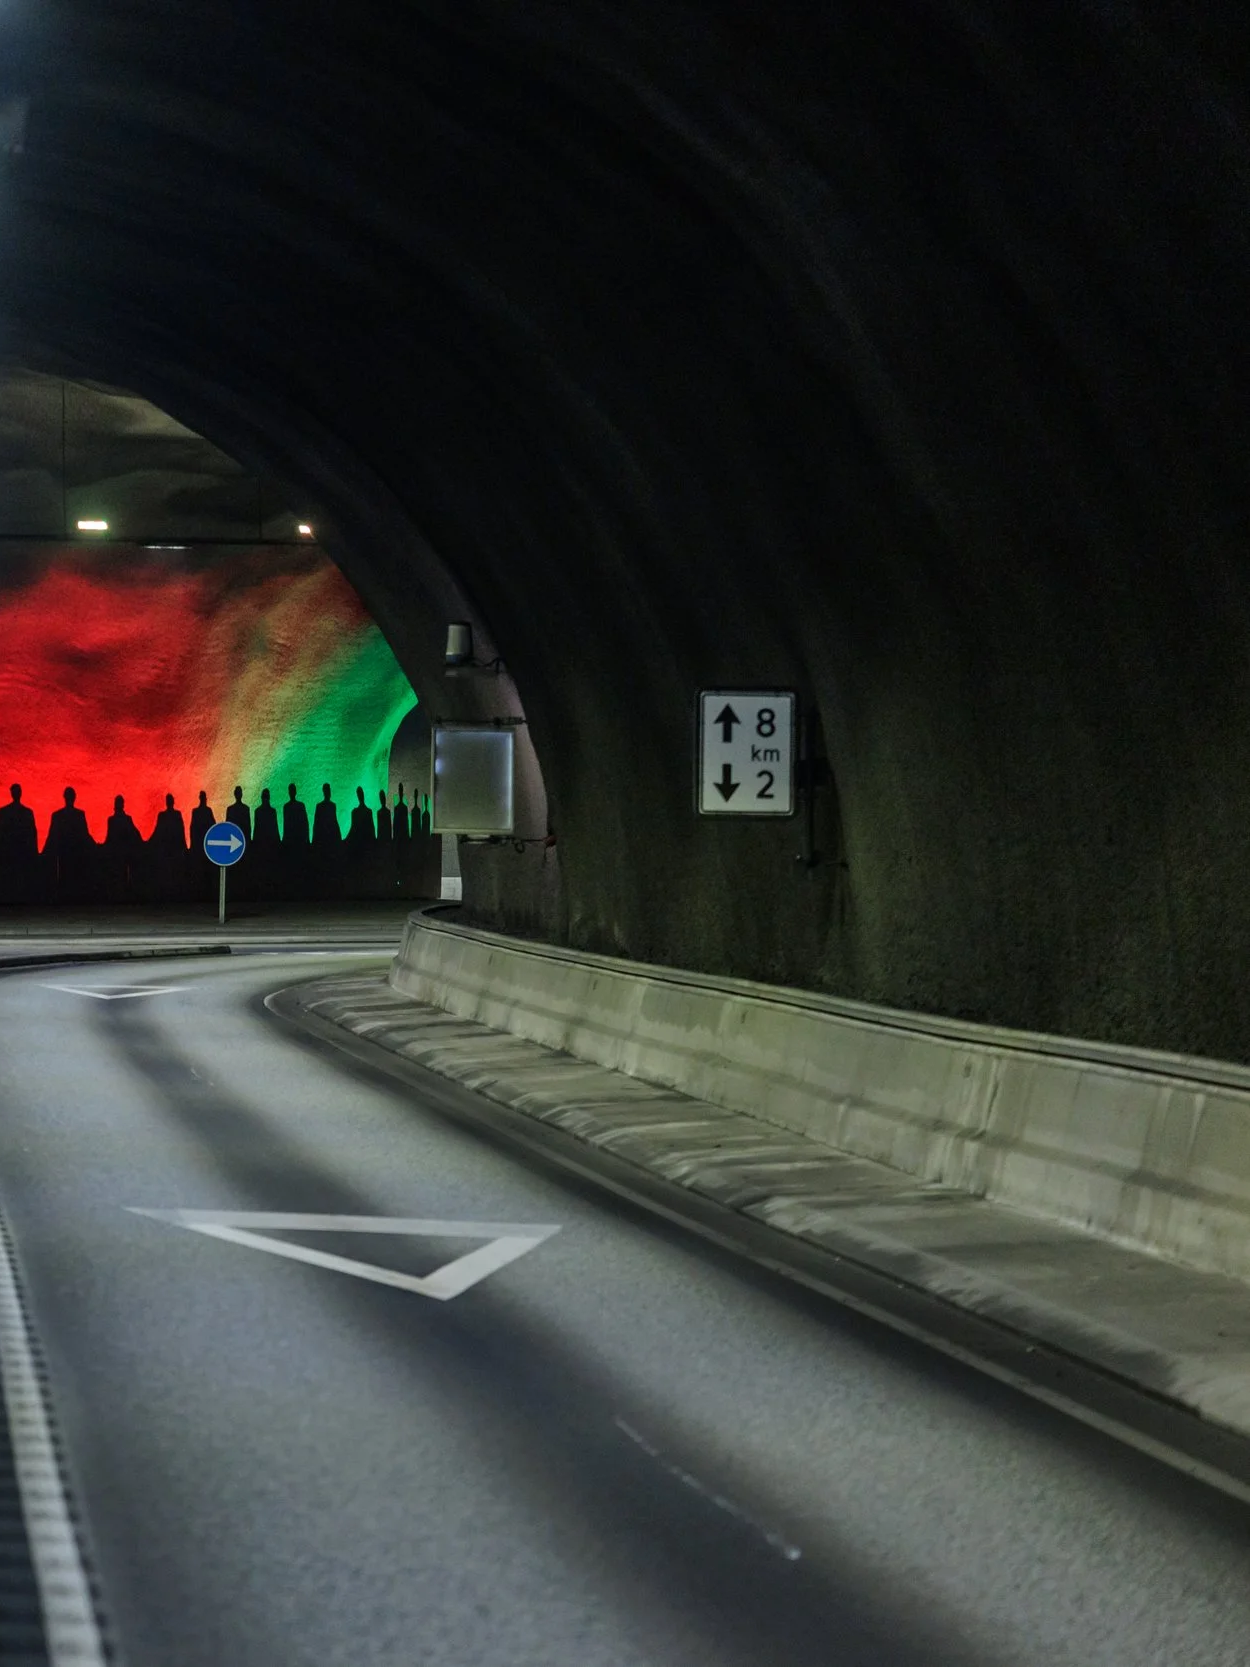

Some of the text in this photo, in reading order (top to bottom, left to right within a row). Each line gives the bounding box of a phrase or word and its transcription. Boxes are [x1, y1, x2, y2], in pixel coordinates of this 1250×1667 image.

[756, 708, 775, 737] 8
[751, 744, 780, 762] km
[756, 770, 774, 799] 2
